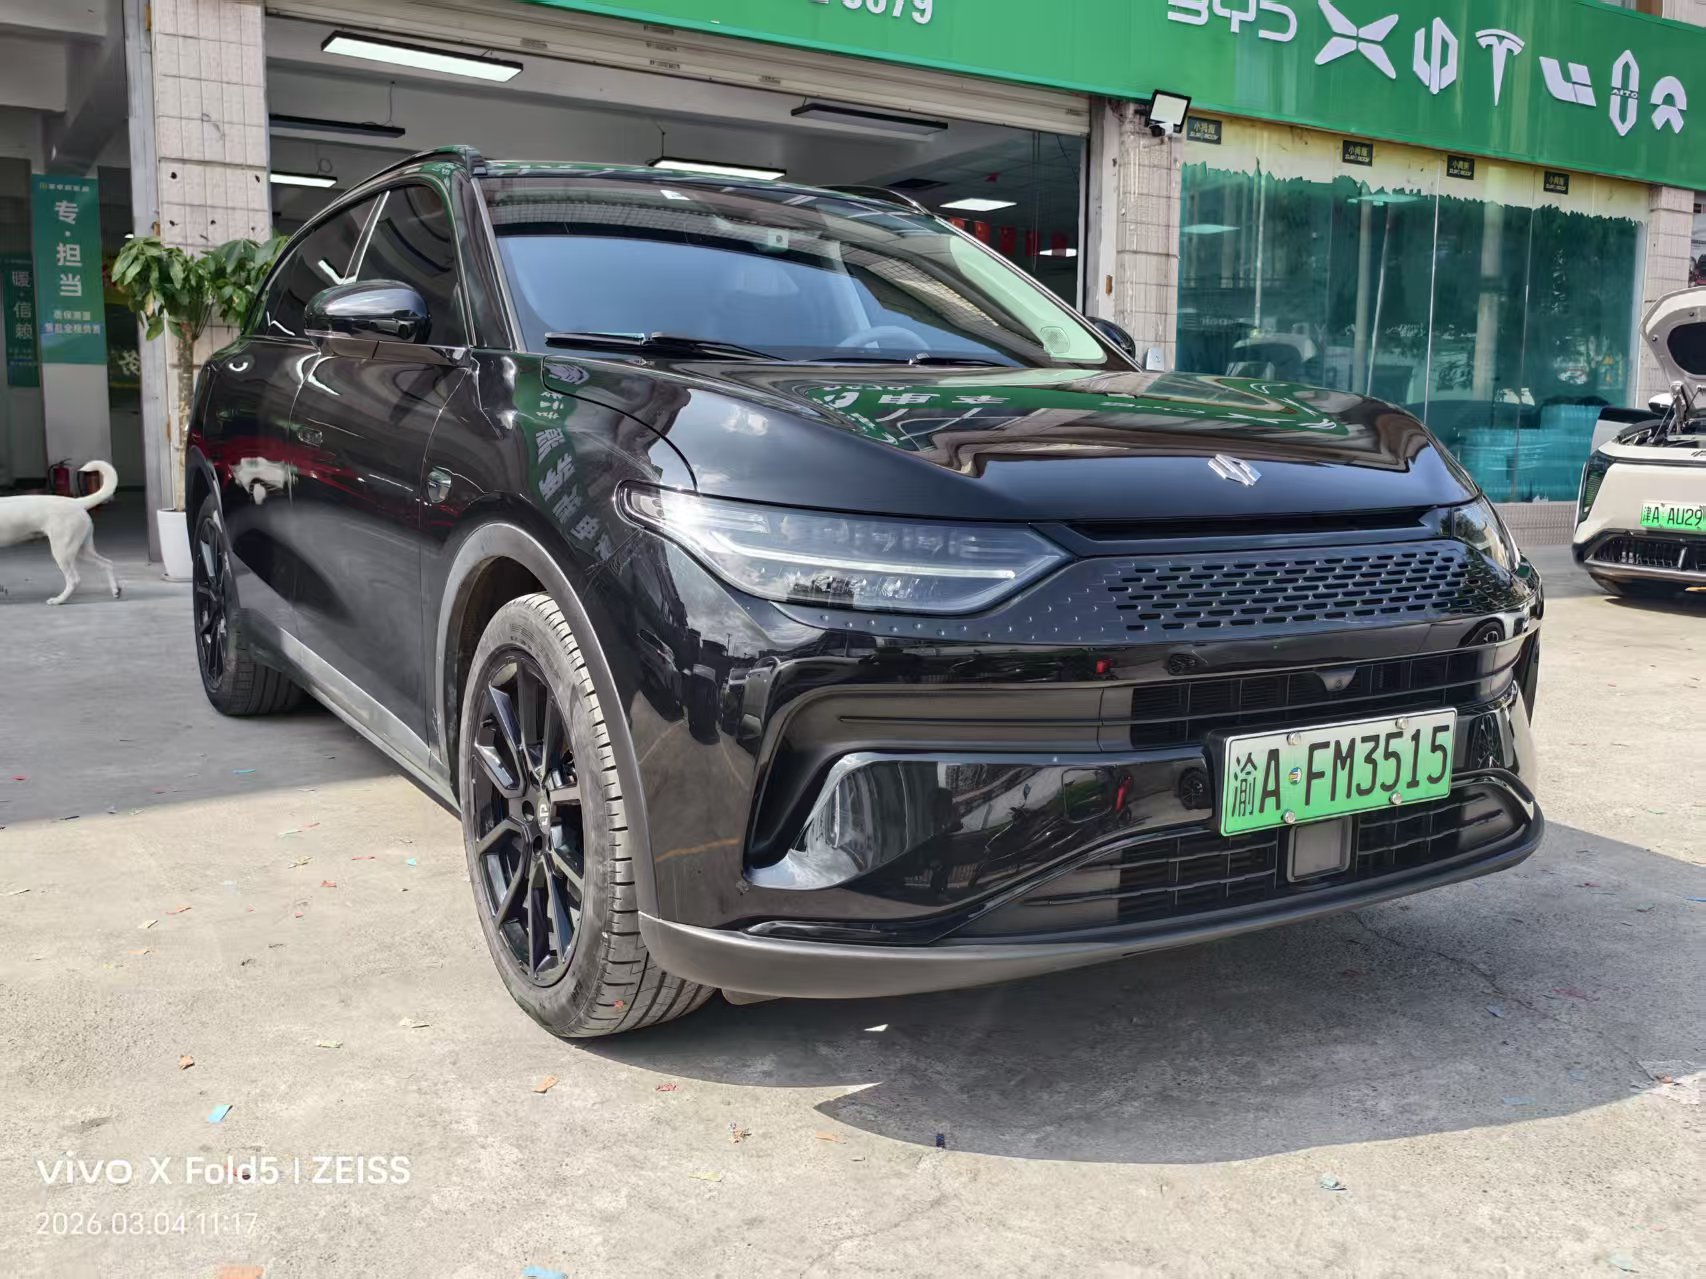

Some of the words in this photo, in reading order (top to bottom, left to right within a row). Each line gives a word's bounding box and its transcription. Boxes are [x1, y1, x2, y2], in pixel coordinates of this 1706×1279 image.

[1611, 88, 1638, 98] AITO
[1231, 748, 1281, 817] 渝A
[1305, 724, 1450, 806] FM3515
